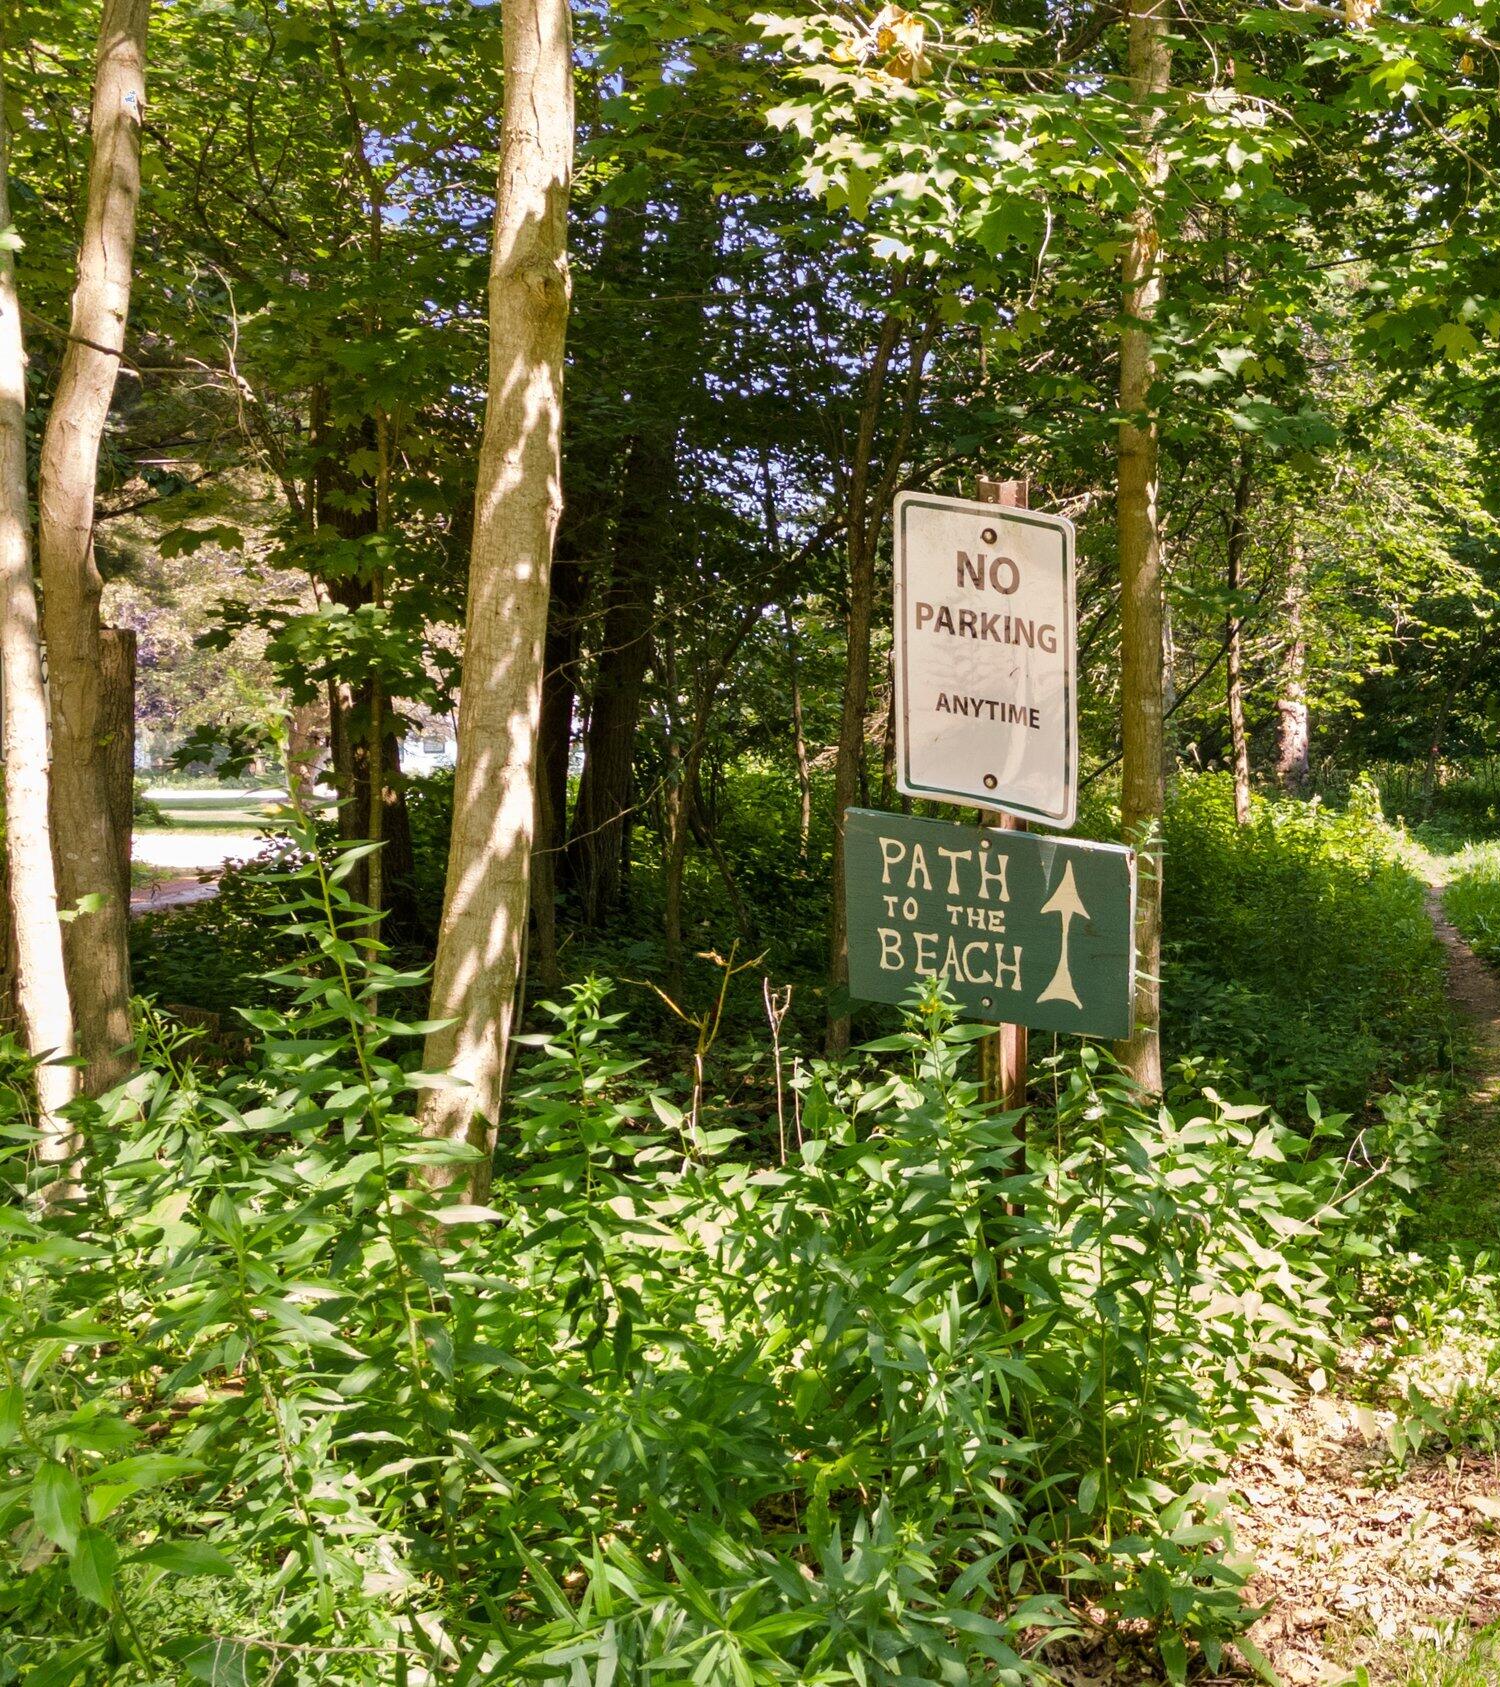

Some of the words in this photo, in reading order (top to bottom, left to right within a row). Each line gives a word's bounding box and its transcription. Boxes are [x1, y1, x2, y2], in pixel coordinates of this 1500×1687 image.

[957, 551, 1020, 595] NO
[915, 602, 1057, 654] PARKING
[936, 692, 1040, 730] ANYTIME
[879, 837, 1009, 902] PATH
[883, 895, 918, 920] TO
[946, 904, 1006, 933] THE
[877, 927, 1023, 991] BEACH
